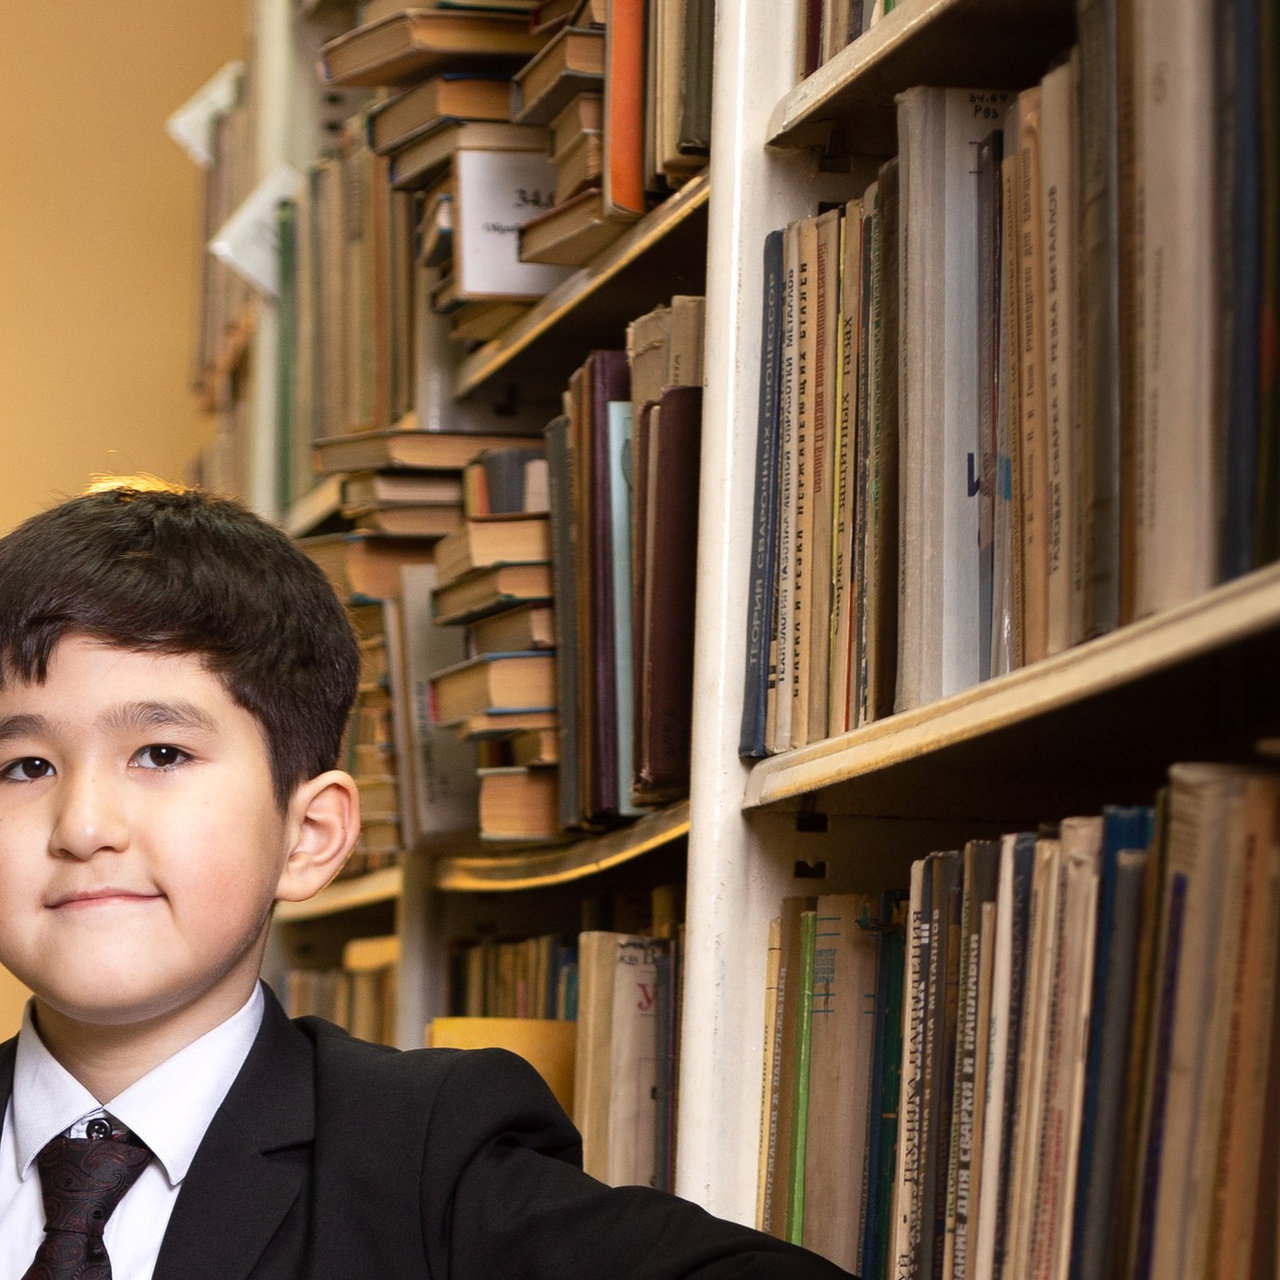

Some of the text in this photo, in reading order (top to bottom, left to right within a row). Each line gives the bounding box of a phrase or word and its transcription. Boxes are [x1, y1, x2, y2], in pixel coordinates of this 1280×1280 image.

[843, 315, 853, 377] газах
[748, 272, 776, 667] ТЕОРИЯ СВАРОЧНЫХ ПРОЦЕССОВ
[839, 392, 851, 511] защитных
[908, 908, 922, 1066] НАПЫЛЕНИЯ
[928, 908, 940, 1011] МЕТАЛЛОВ
[964, 933, 979, 1050] НАПЛАВКИ
[962, 1056, 974, 1074] И
[959, 1081, 973, 1162] СВАРКИ
[956, 1169, 970, 1217] ДЛЯ
